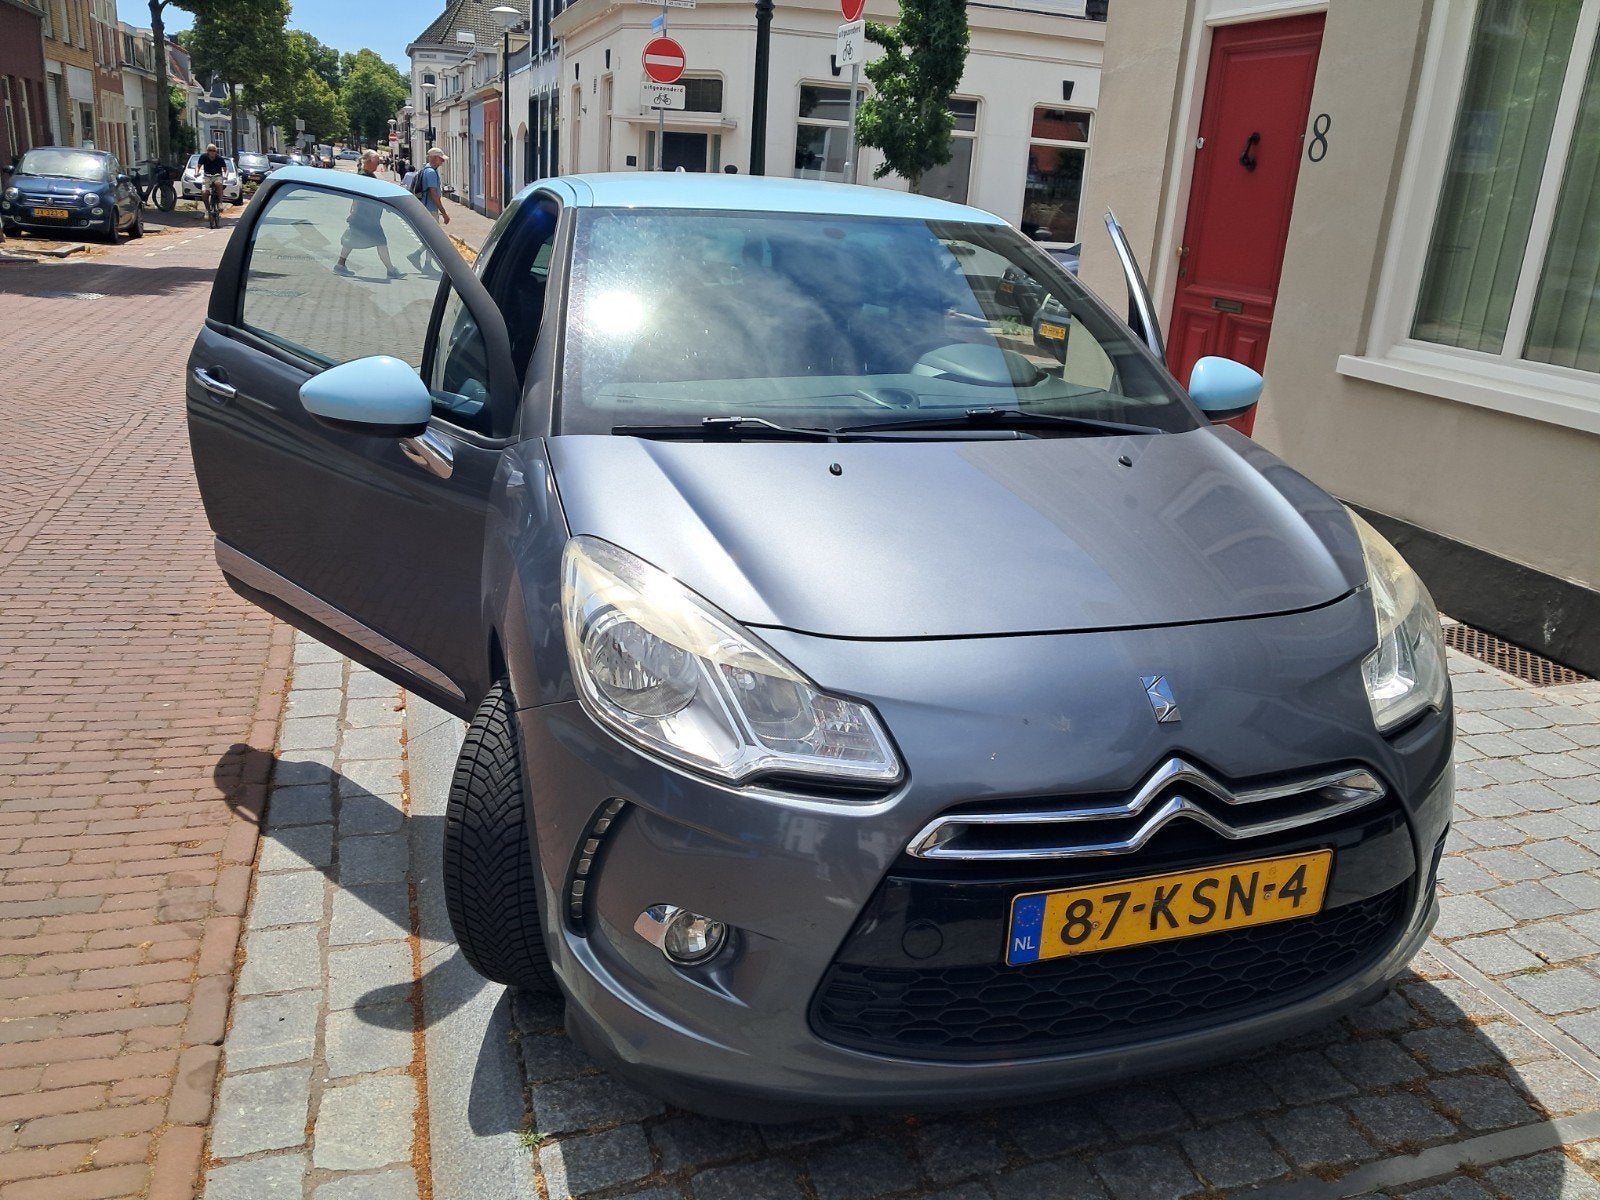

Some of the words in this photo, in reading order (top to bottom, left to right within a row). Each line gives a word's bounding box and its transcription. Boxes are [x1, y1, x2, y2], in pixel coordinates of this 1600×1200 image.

[643, 84, 684, 92] uitgezonderd
[1308, 113, 1331, 163] 8
[1060, 864, 1308, 946] 87-KSN-4
[1014, 935, 1036, 951] NL
